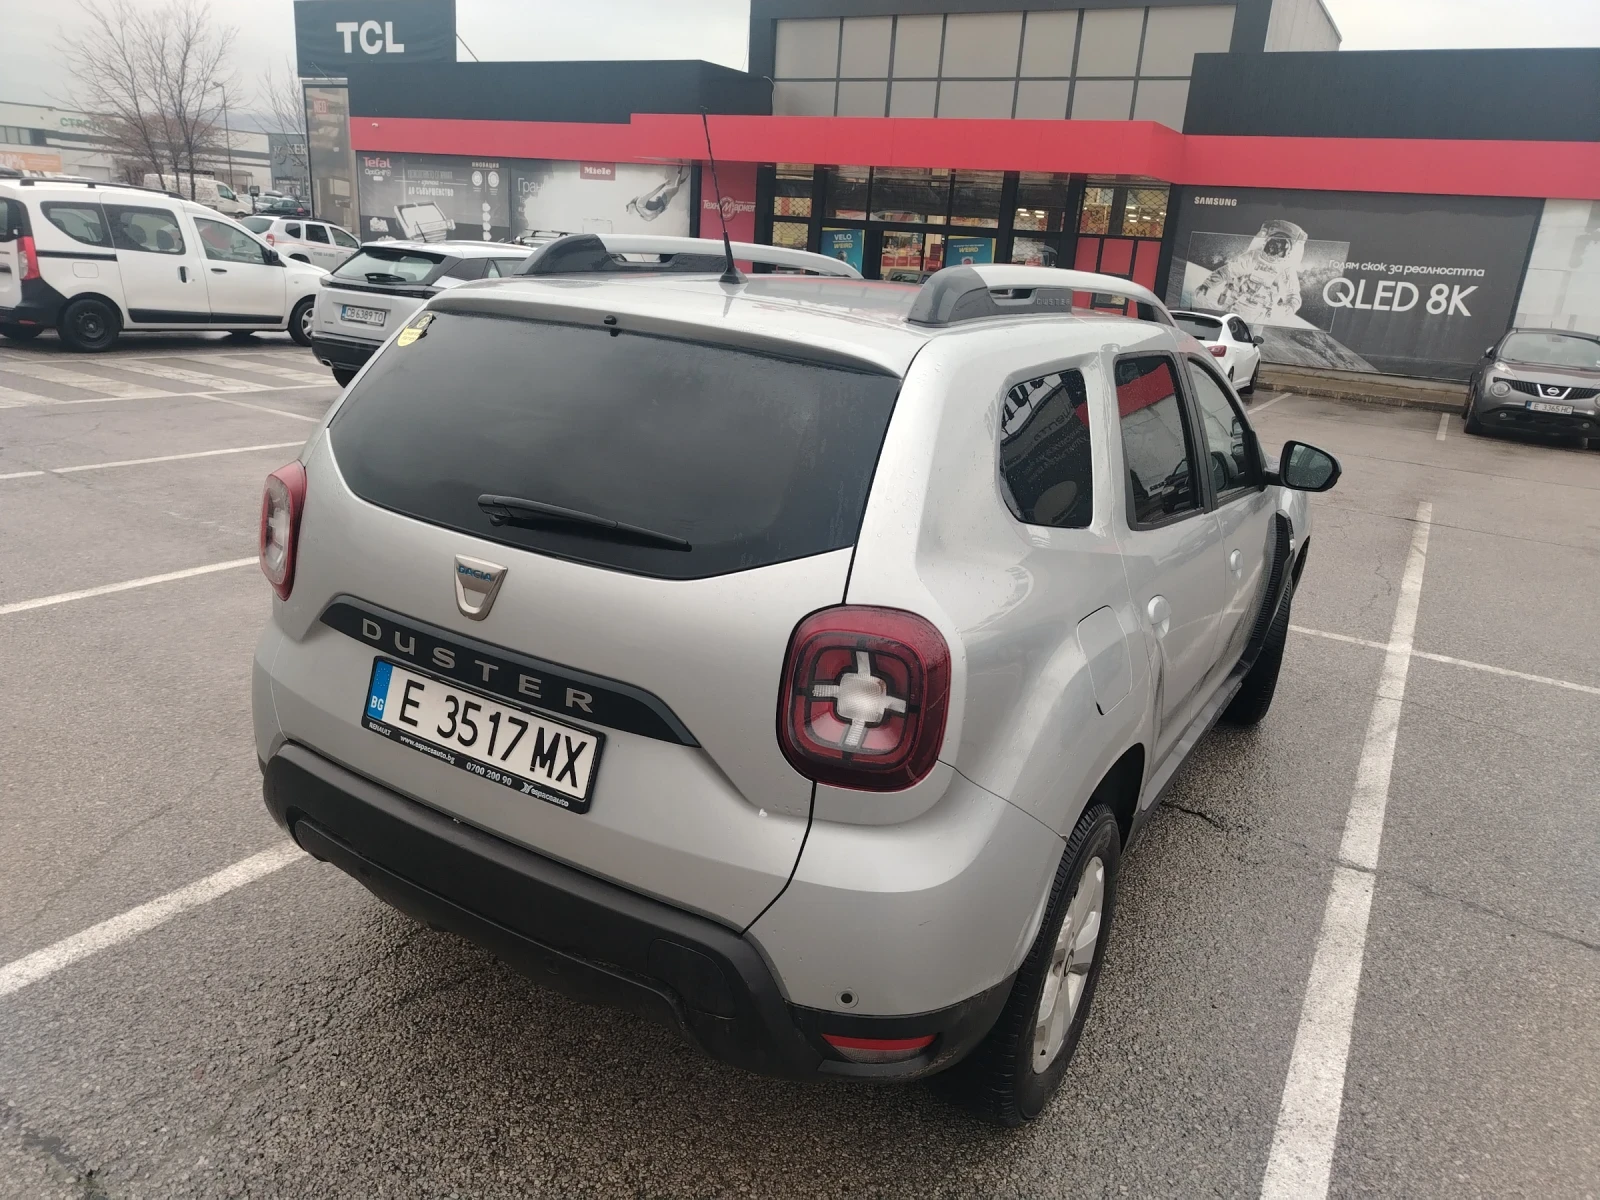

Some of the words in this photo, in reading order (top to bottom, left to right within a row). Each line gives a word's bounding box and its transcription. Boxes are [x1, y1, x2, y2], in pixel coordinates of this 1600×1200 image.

[336, 20, 404, 54] TCL
[363, 156, 392, 168] Tefal
[584, 166, 612, 176] Miele
[1194, 196, 1238, 206] SAMSUNG
[834, 233, 852, 241] VELO
[1328, 260, 1360, 270] Голям
[1361, 261, 1388, 272] скок
[1388, 264, 1403, 275] за
[1404, 264, 1485, 277] реалността
[1322, 277, 1419, 312] QLED
[1426, 283, 1479, 317] 8K
[1541, 404, 1560, 412] 3365
[458, 565, 492, 582] DACIA
[361, 618, 593, 713] DUSTER
[370, 695, 384, 711] BG
[399, 679, 425, 728] E
[437, 695, 529, 761] 3517
[529, 726, 588, 789] MX
[368, 721, 392, 736] RENAULT
[400, 735, 456, 765] www.espaceauto.bg
[466, 762, 485, 776] 0700
[486, 769, 501, 782] 200
[501, 775, 513, 786] 90
[530, 787, 569, 808] espaceauto
